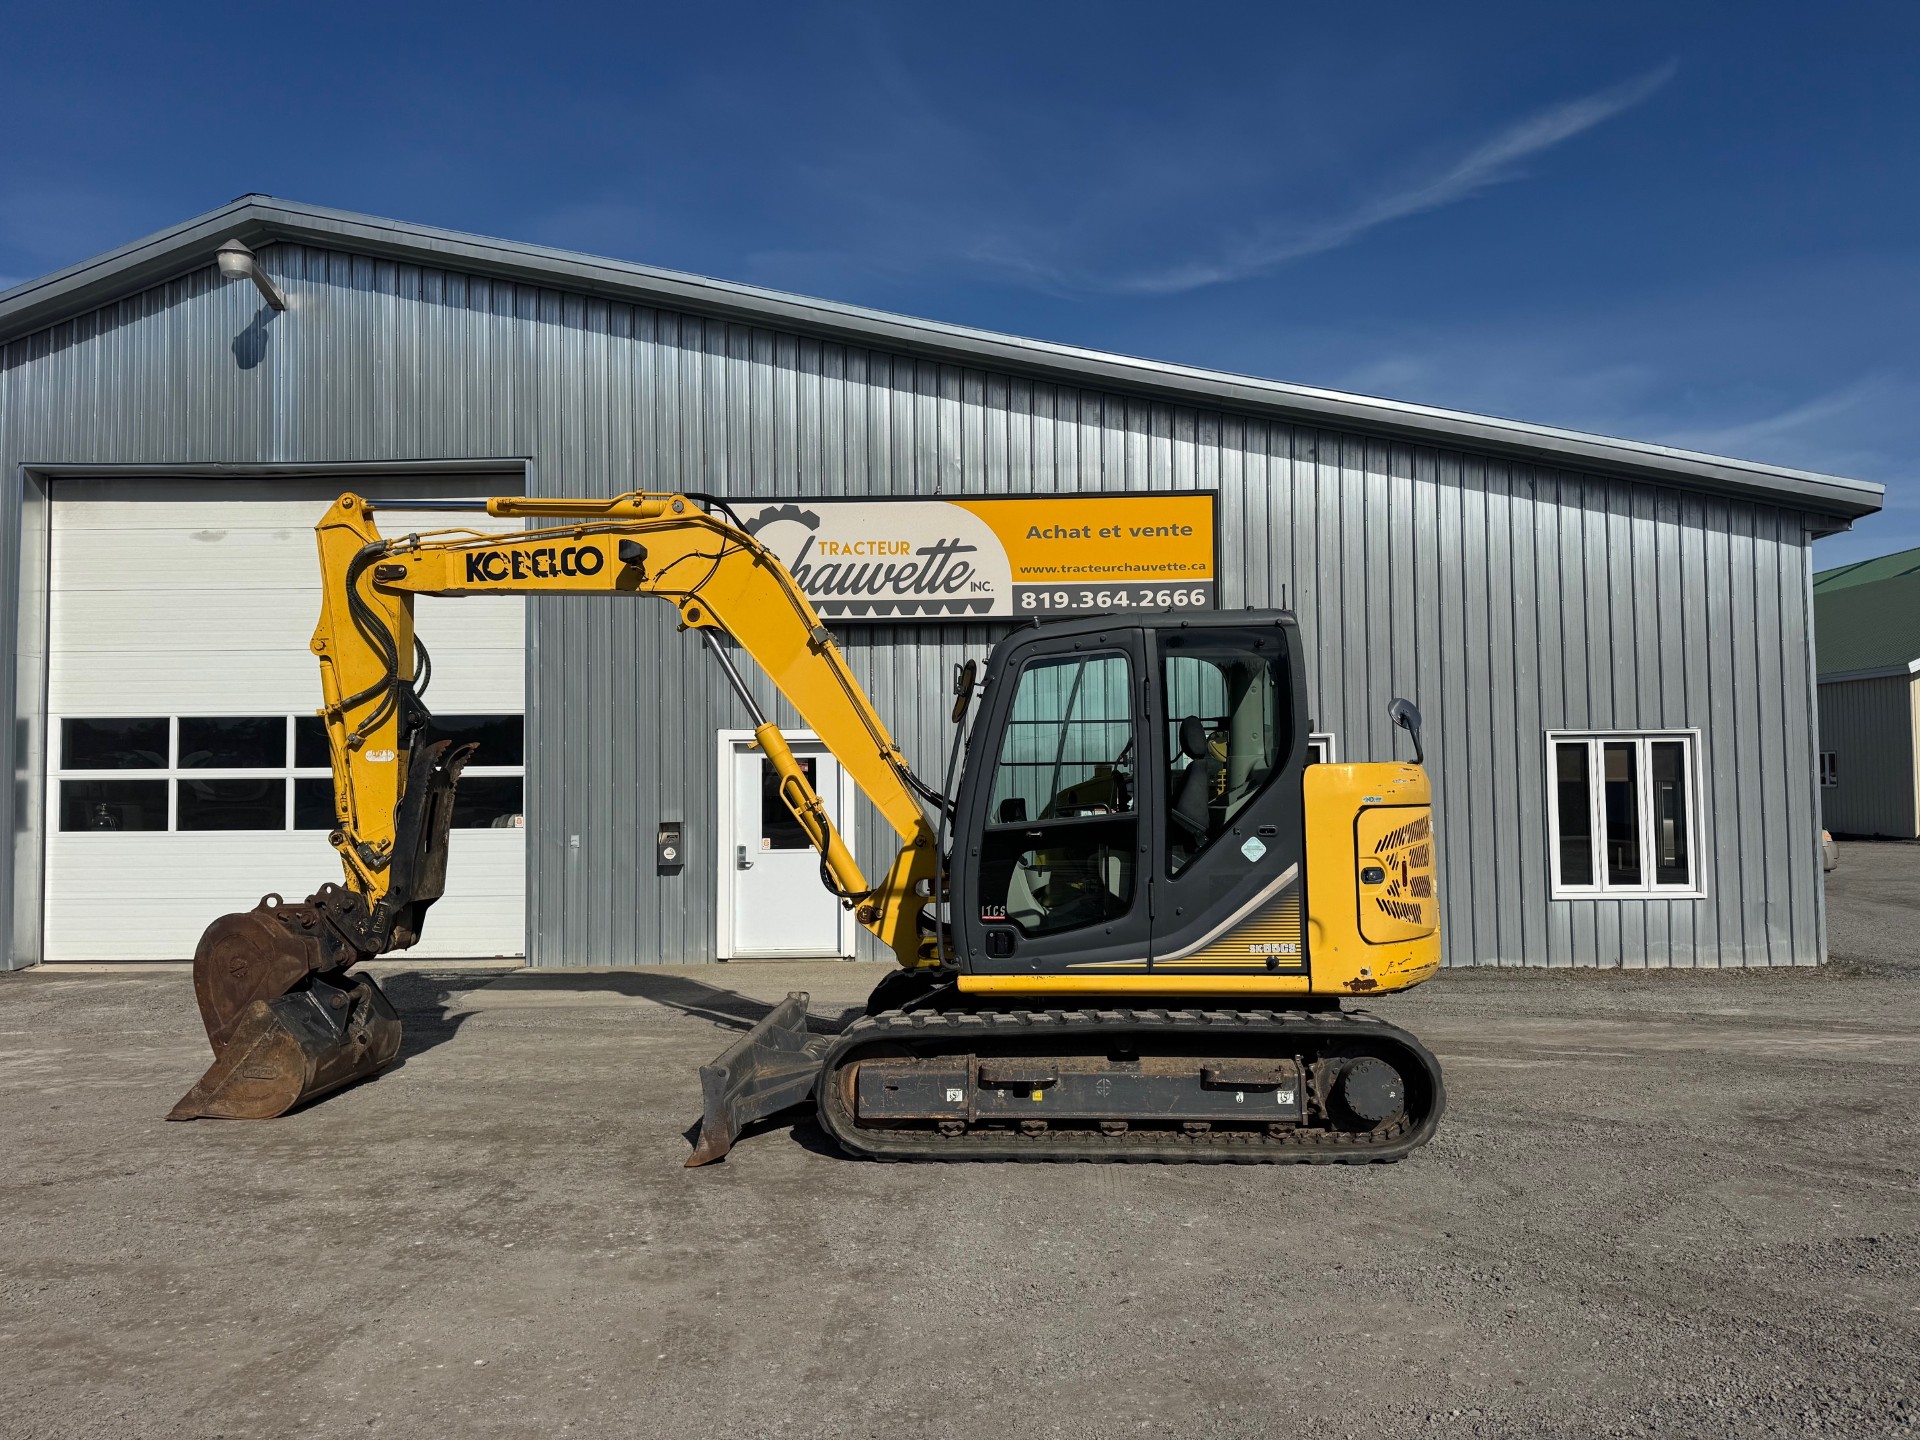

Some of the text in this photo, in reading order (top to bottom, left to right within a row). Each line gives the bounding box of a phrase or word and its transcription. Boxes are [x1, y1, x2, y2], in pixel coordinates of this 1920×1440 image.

[1026, 522, 1193, 539] Achat et vente
[818, 541, 910, 556] TRACTEUR
[1020, 562, 1206, 574] www.tracteurchauvette.ca
[970, 581, 994, 593] INC.
[1021, 588, 1206, 609] 819.364.2666
[981, 904, 1006, 916] ITCS
